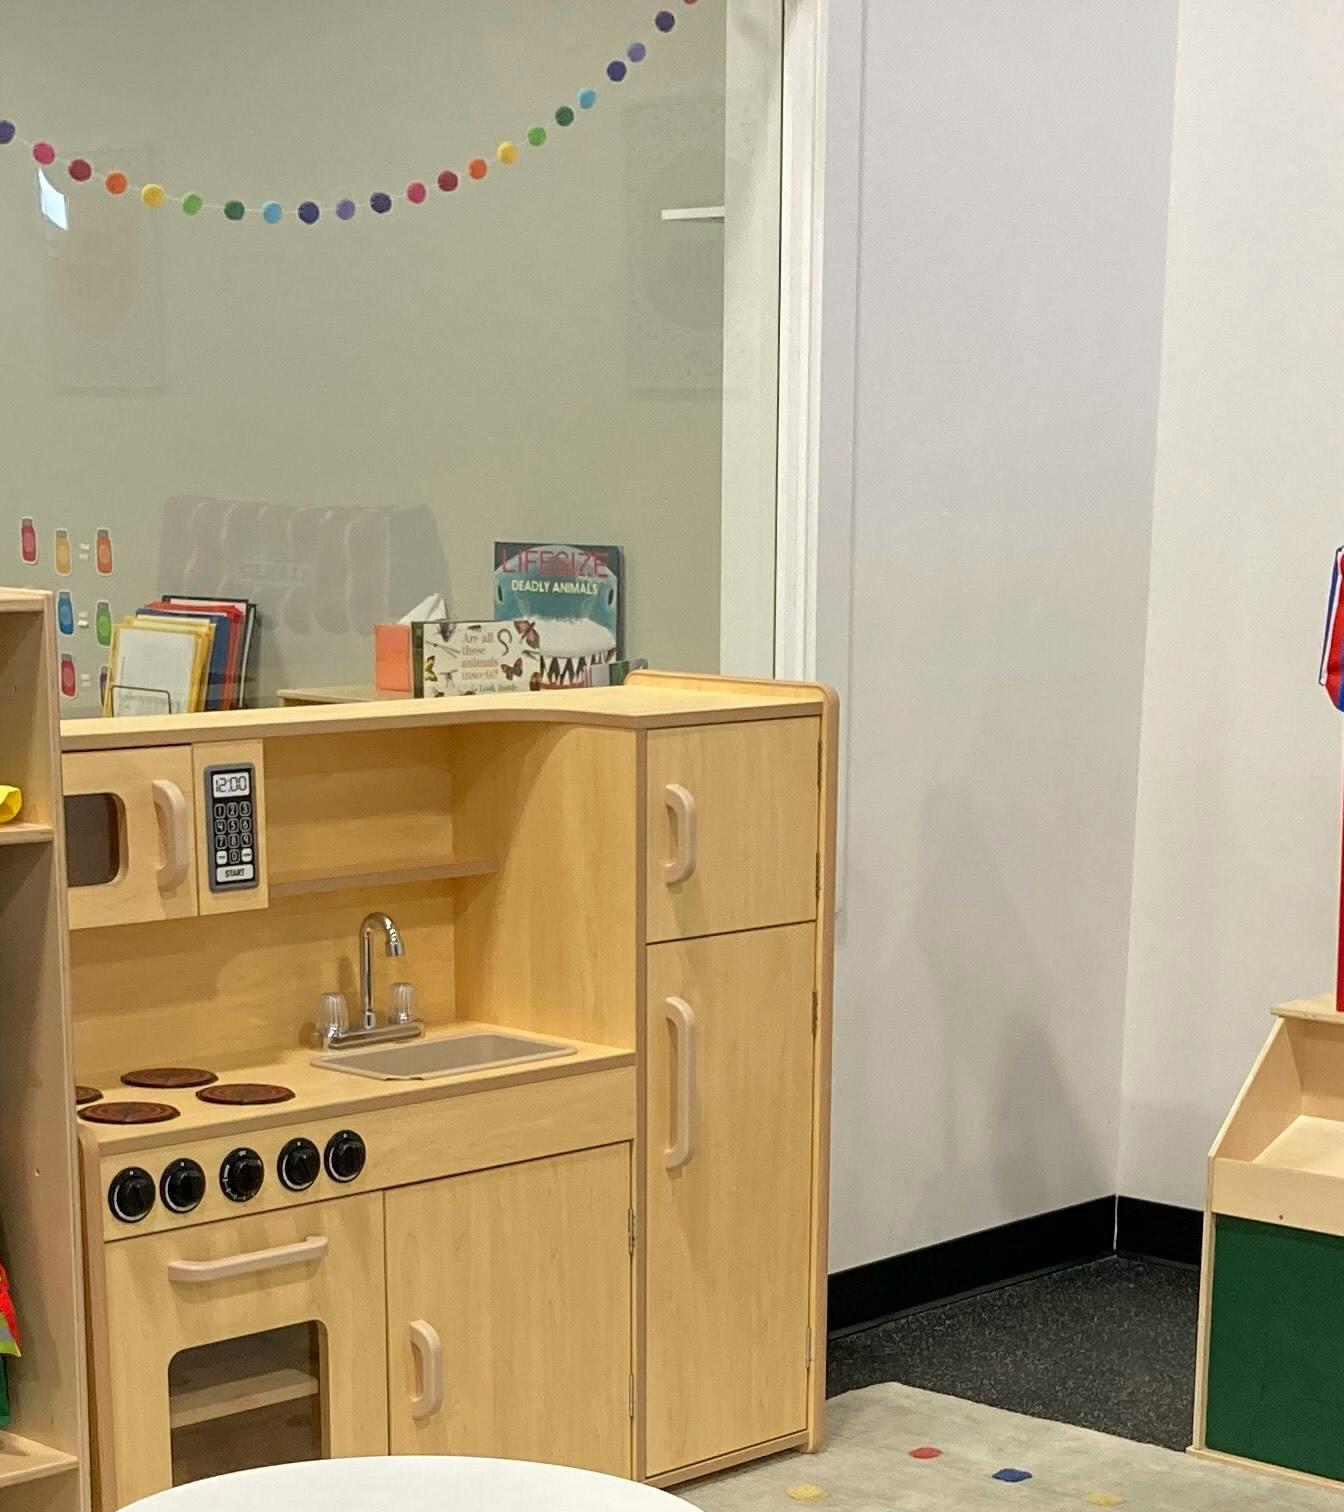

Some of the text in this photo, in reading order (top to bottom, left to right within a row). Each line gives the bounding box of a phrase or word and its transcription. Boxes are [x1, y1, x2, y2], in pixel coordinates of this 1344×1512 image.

[501, 547, 609, 579] LIFESIZE
[511, 579, 598, 596] DEADLY ANIMALS
[216, 775, 248, 793] 12:00
[225, 868, 245, 878] START
